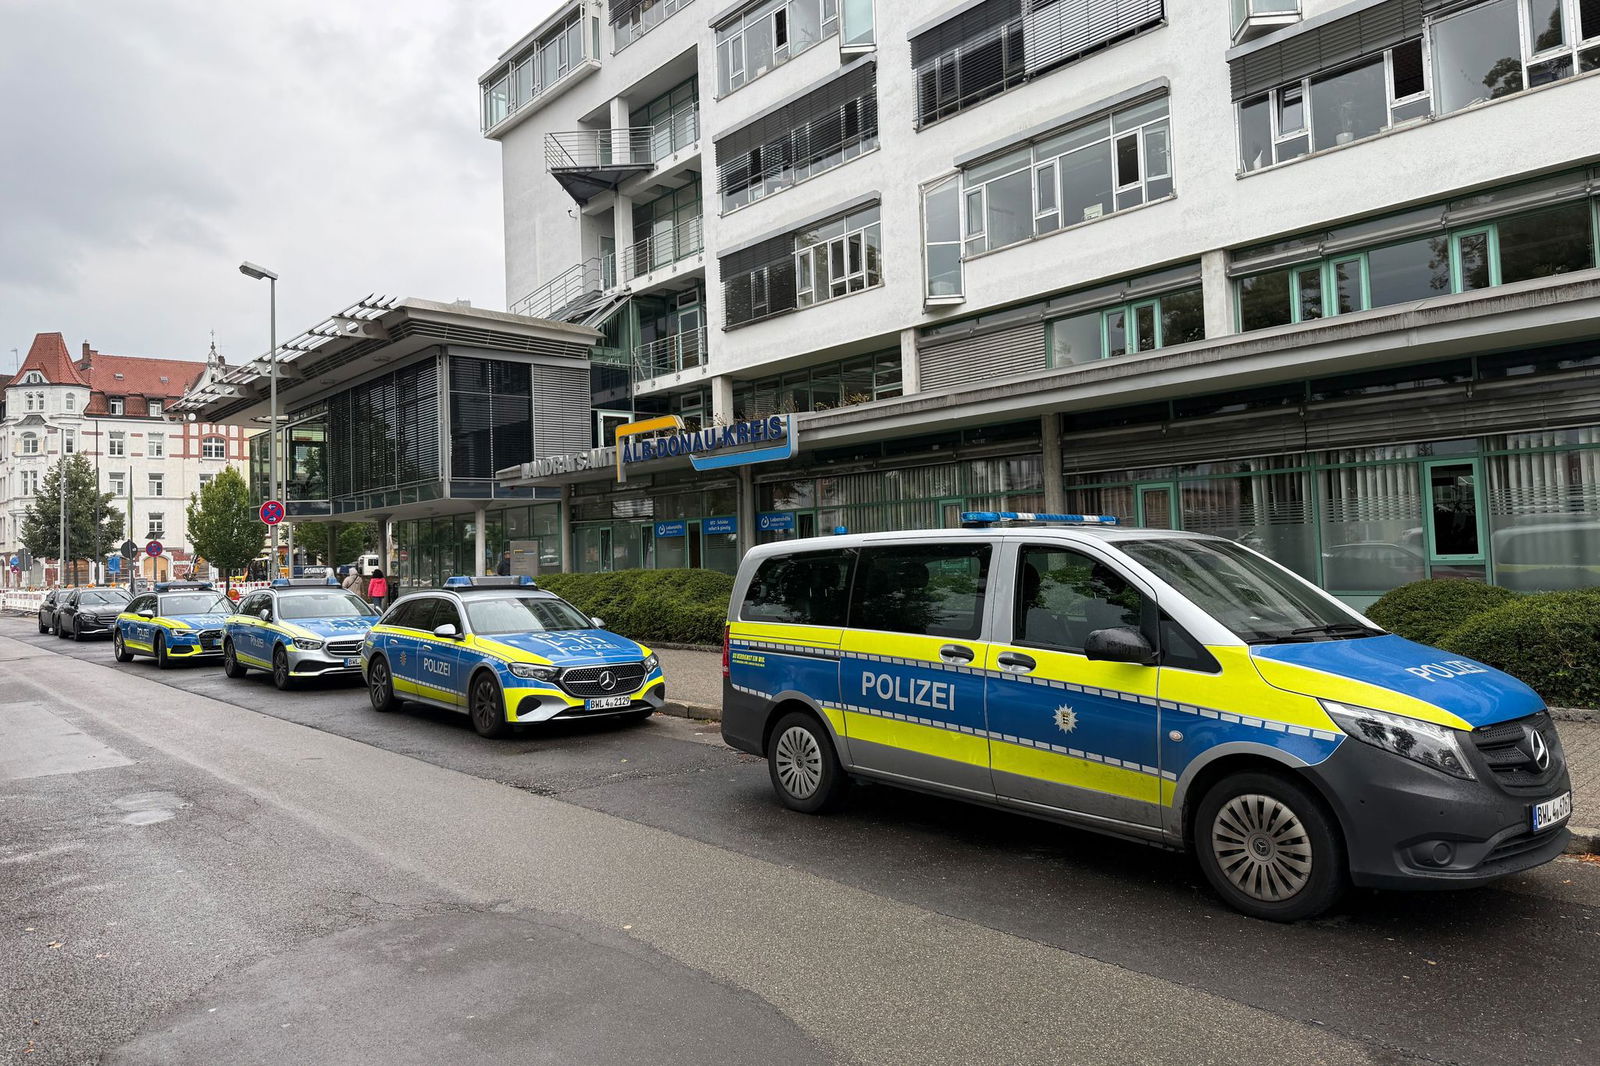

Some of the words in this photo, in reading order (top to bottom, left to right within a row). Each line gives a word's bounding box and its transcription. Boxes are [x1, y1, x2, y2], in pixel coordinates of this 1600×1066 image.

[521, 451, 614, 480] LANDRATSAMT
[622, 416, 783, 464] ALB-DONAU-KREIS
[423, 657, 451, 677] POLIZEI
[1404, 660, 1489, 682] POLIZEI
[862, 671, 955, 711] POLIZEI
[591, 699, 605, 709] BWL
[1537, 803, 1552, 826] BWL
